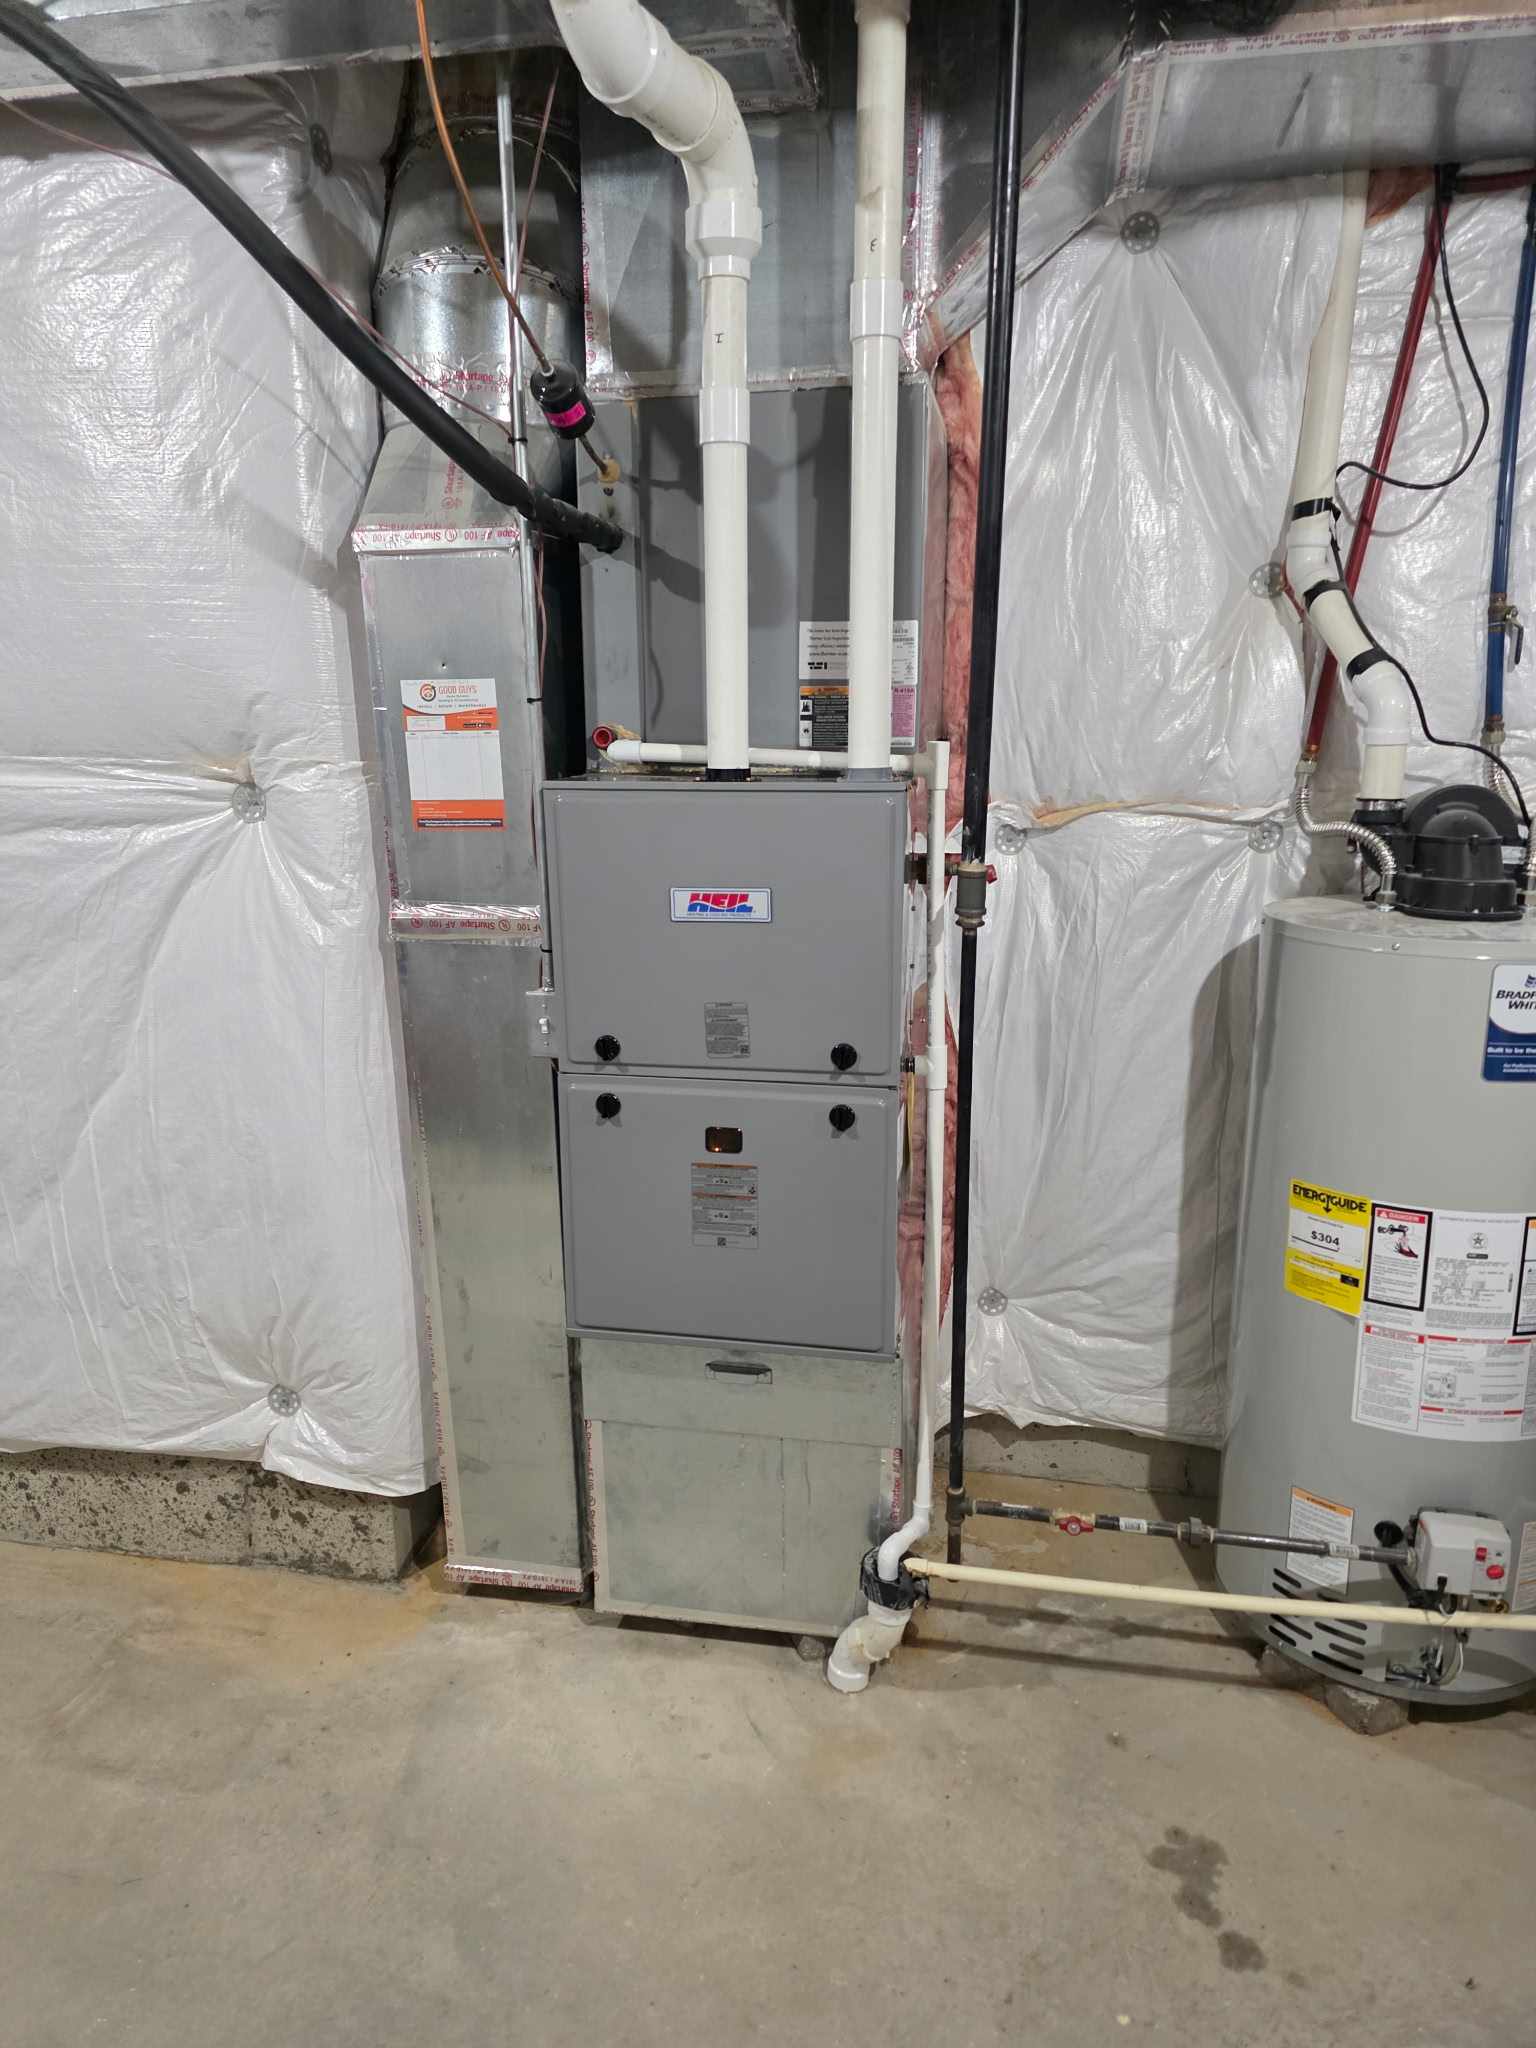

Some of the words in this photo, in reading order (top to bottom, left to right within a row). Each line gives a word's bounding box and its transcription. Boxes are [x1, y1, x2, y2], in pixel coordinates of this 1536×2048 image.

[585, 310, 593, 326] AF
[586, 327, 594, 343] 100
[455, 370, 494, 382] Shurtape
[464, 531, 478, 540] 100
[439, 686, 456, 694] GOOD
[458, 685, 476, 693] GUYS
[687, 893, 754, 913] HEIL
[446, 920, 455, 928] AF
[460, 920, 495, 930] Shurtape
[517, 923, 530, 931] 100
[1293, 1184, 1367, 1213] ENERGYGUIDE
[1389, 1213, 1419, 1222] DANGER
[1310, 1230, 1340, 1246] $304
[893, 1448, 901, 1461] 100
[440, 1465, 448, 1491] 181B-FX
[891, 1477, 901, 1509] Shurtape
[468, 1575, 499, 1584] Shurtape
